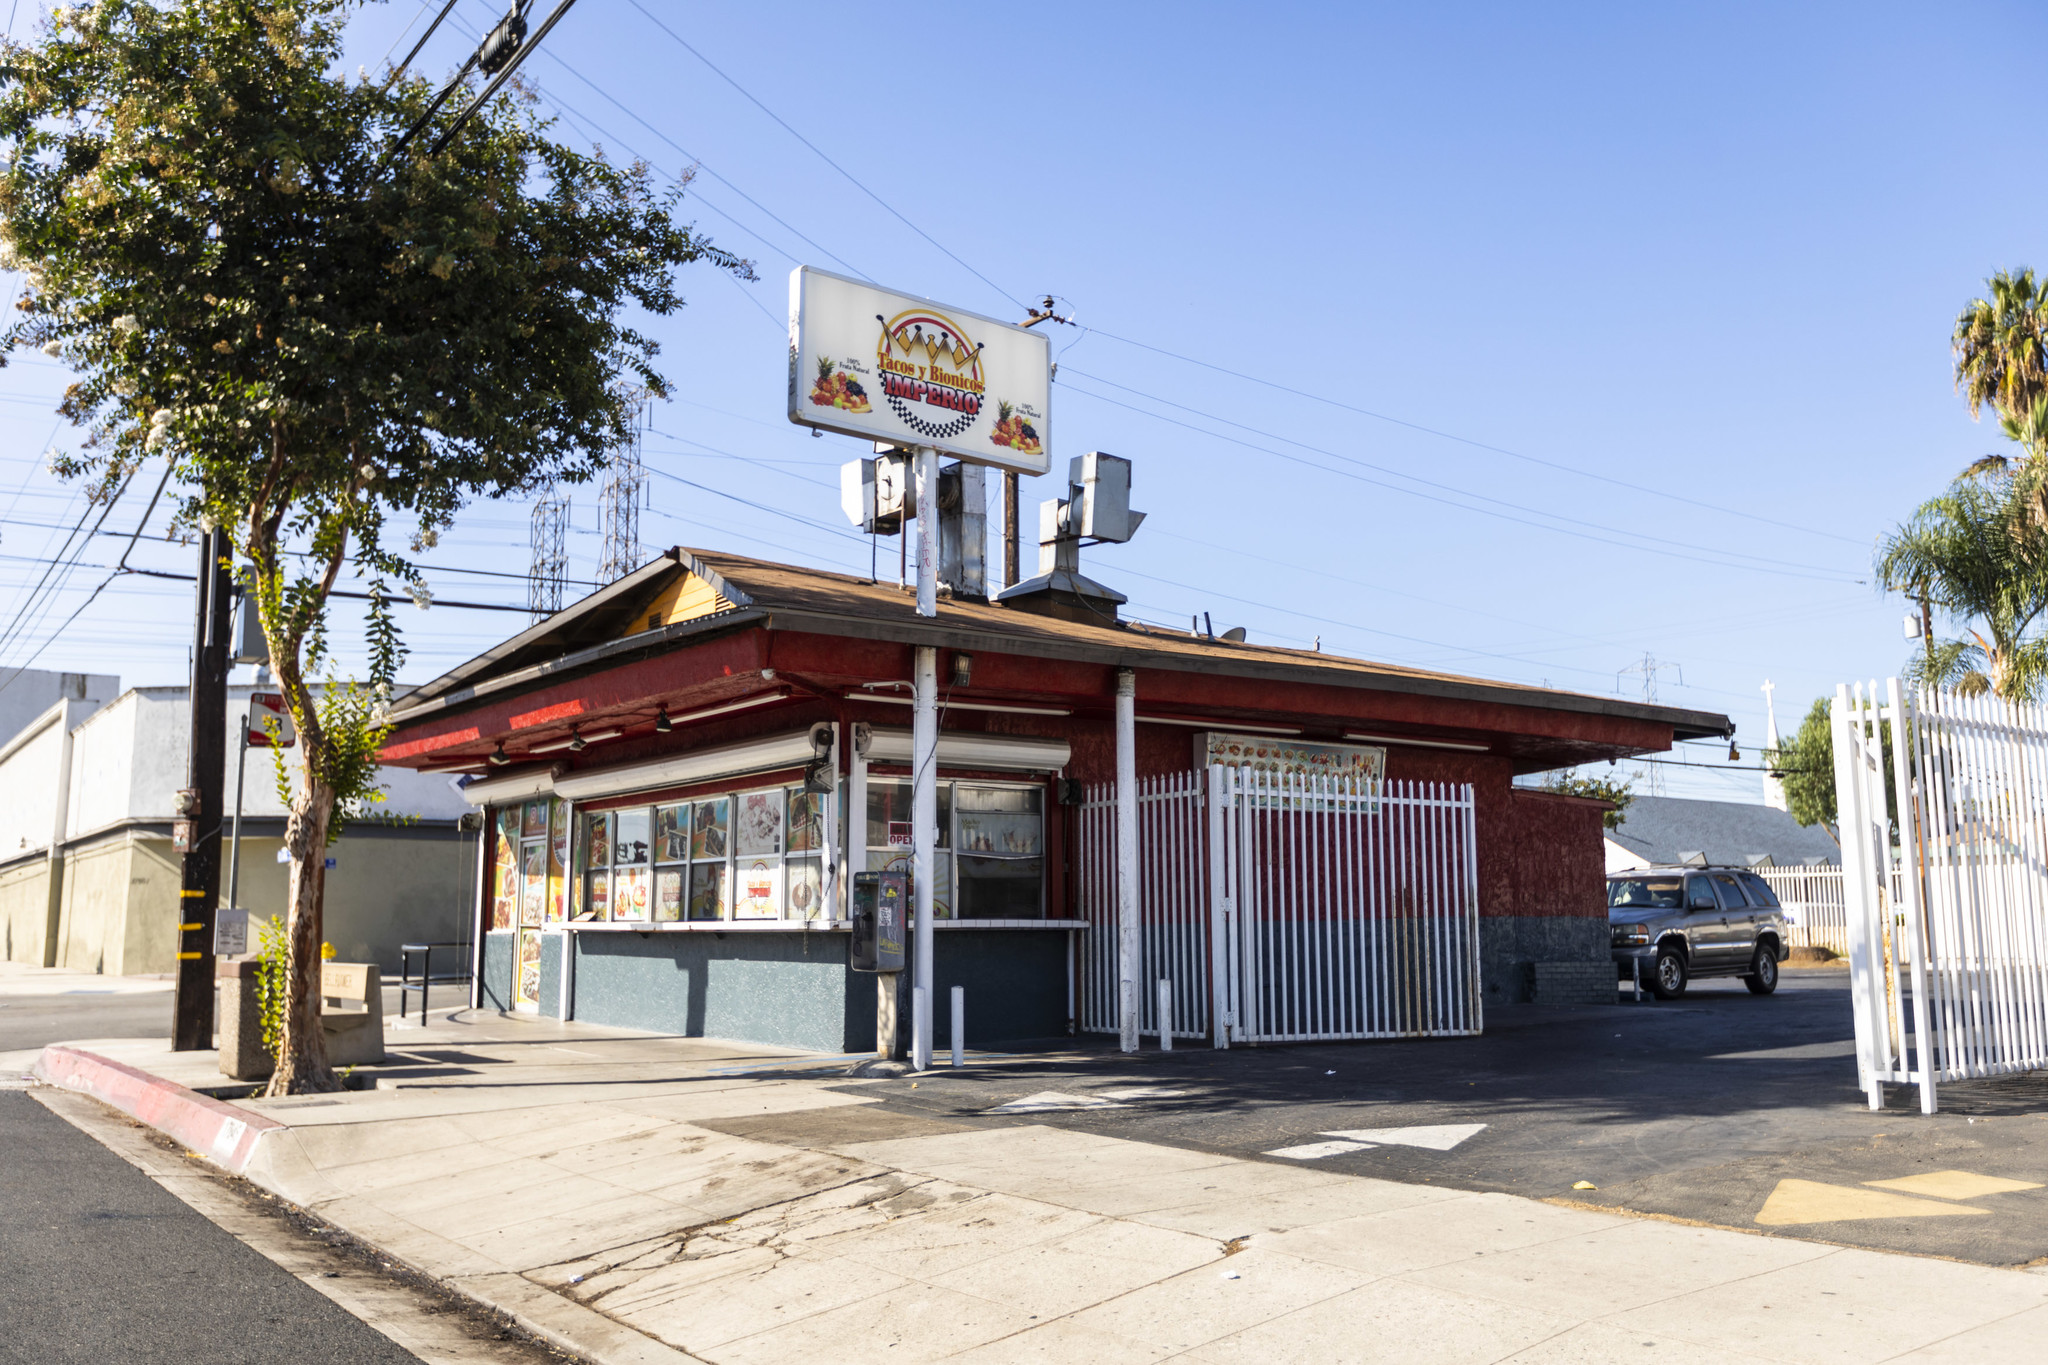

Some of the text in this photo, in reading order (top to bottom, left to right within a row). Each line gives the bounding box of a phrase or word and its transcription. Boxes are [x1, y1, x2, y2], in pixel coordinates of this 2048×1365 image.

[847, 357, 861, 366] 100%
[853, 364, 870, 374] Natural
[877, 351, 984, 395] Tacos y Bionicos
[884, 370, 980, 415] IMPERIO
